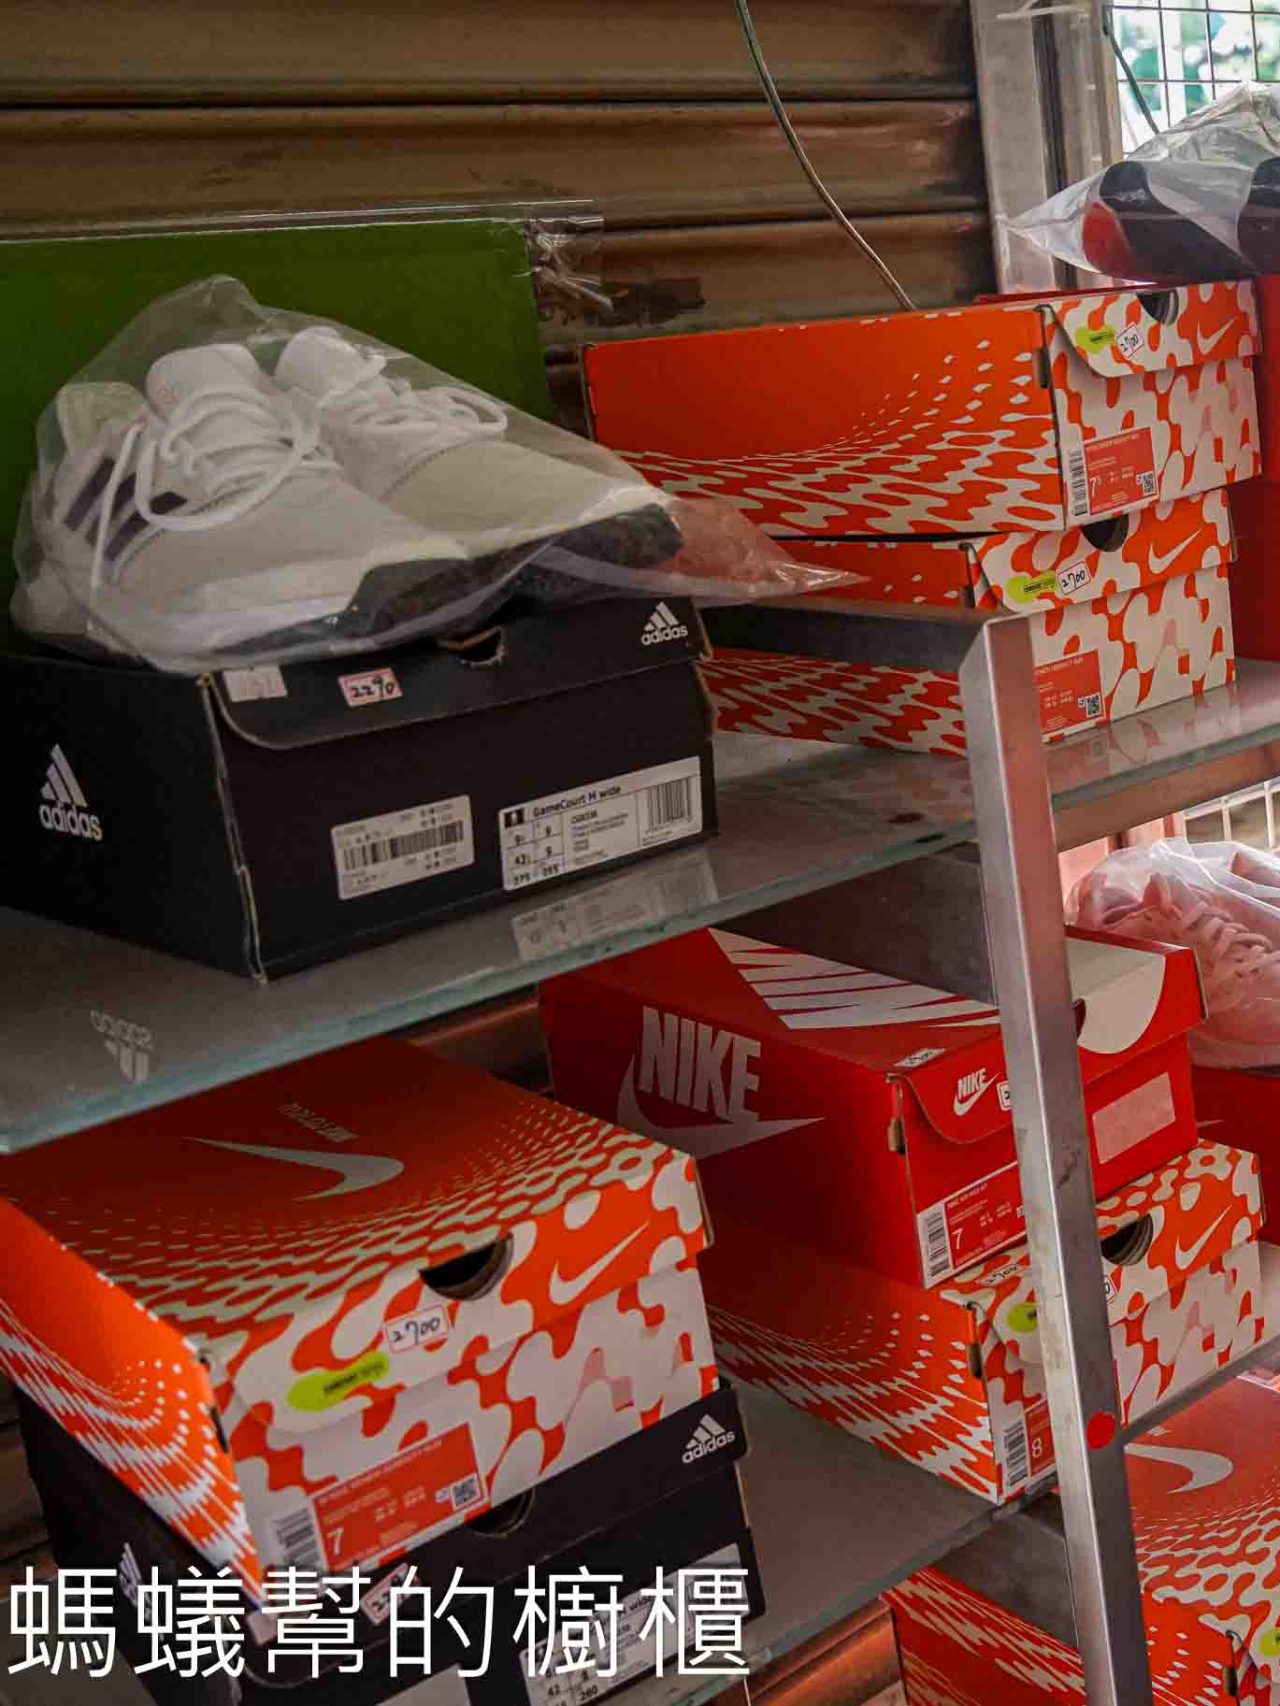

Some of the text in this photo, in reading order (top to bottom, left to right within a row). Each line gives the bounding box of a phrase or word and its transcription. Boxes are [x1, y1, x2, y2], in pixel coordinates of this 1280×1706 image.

[1120, 331, 1139, 354] 2700
[1061, 569, 1086, 589] 2700
[640, 624, 688, 645] adidas
[350, 676, 394, 699] 2290
[38, 803, 103, 842] adidas
[640, 1004, 762, 1123] NIKE
[957, 1067, 987, 1100] NIKE
[952, 1228, 963, 1250] 7
[392, 1317, 441, 1346] 2700
[681, 1428, 736, 1465] adidas
[1031, 1438, 1043, 1459] 8
[326, 1527, 344, 1556] 7
